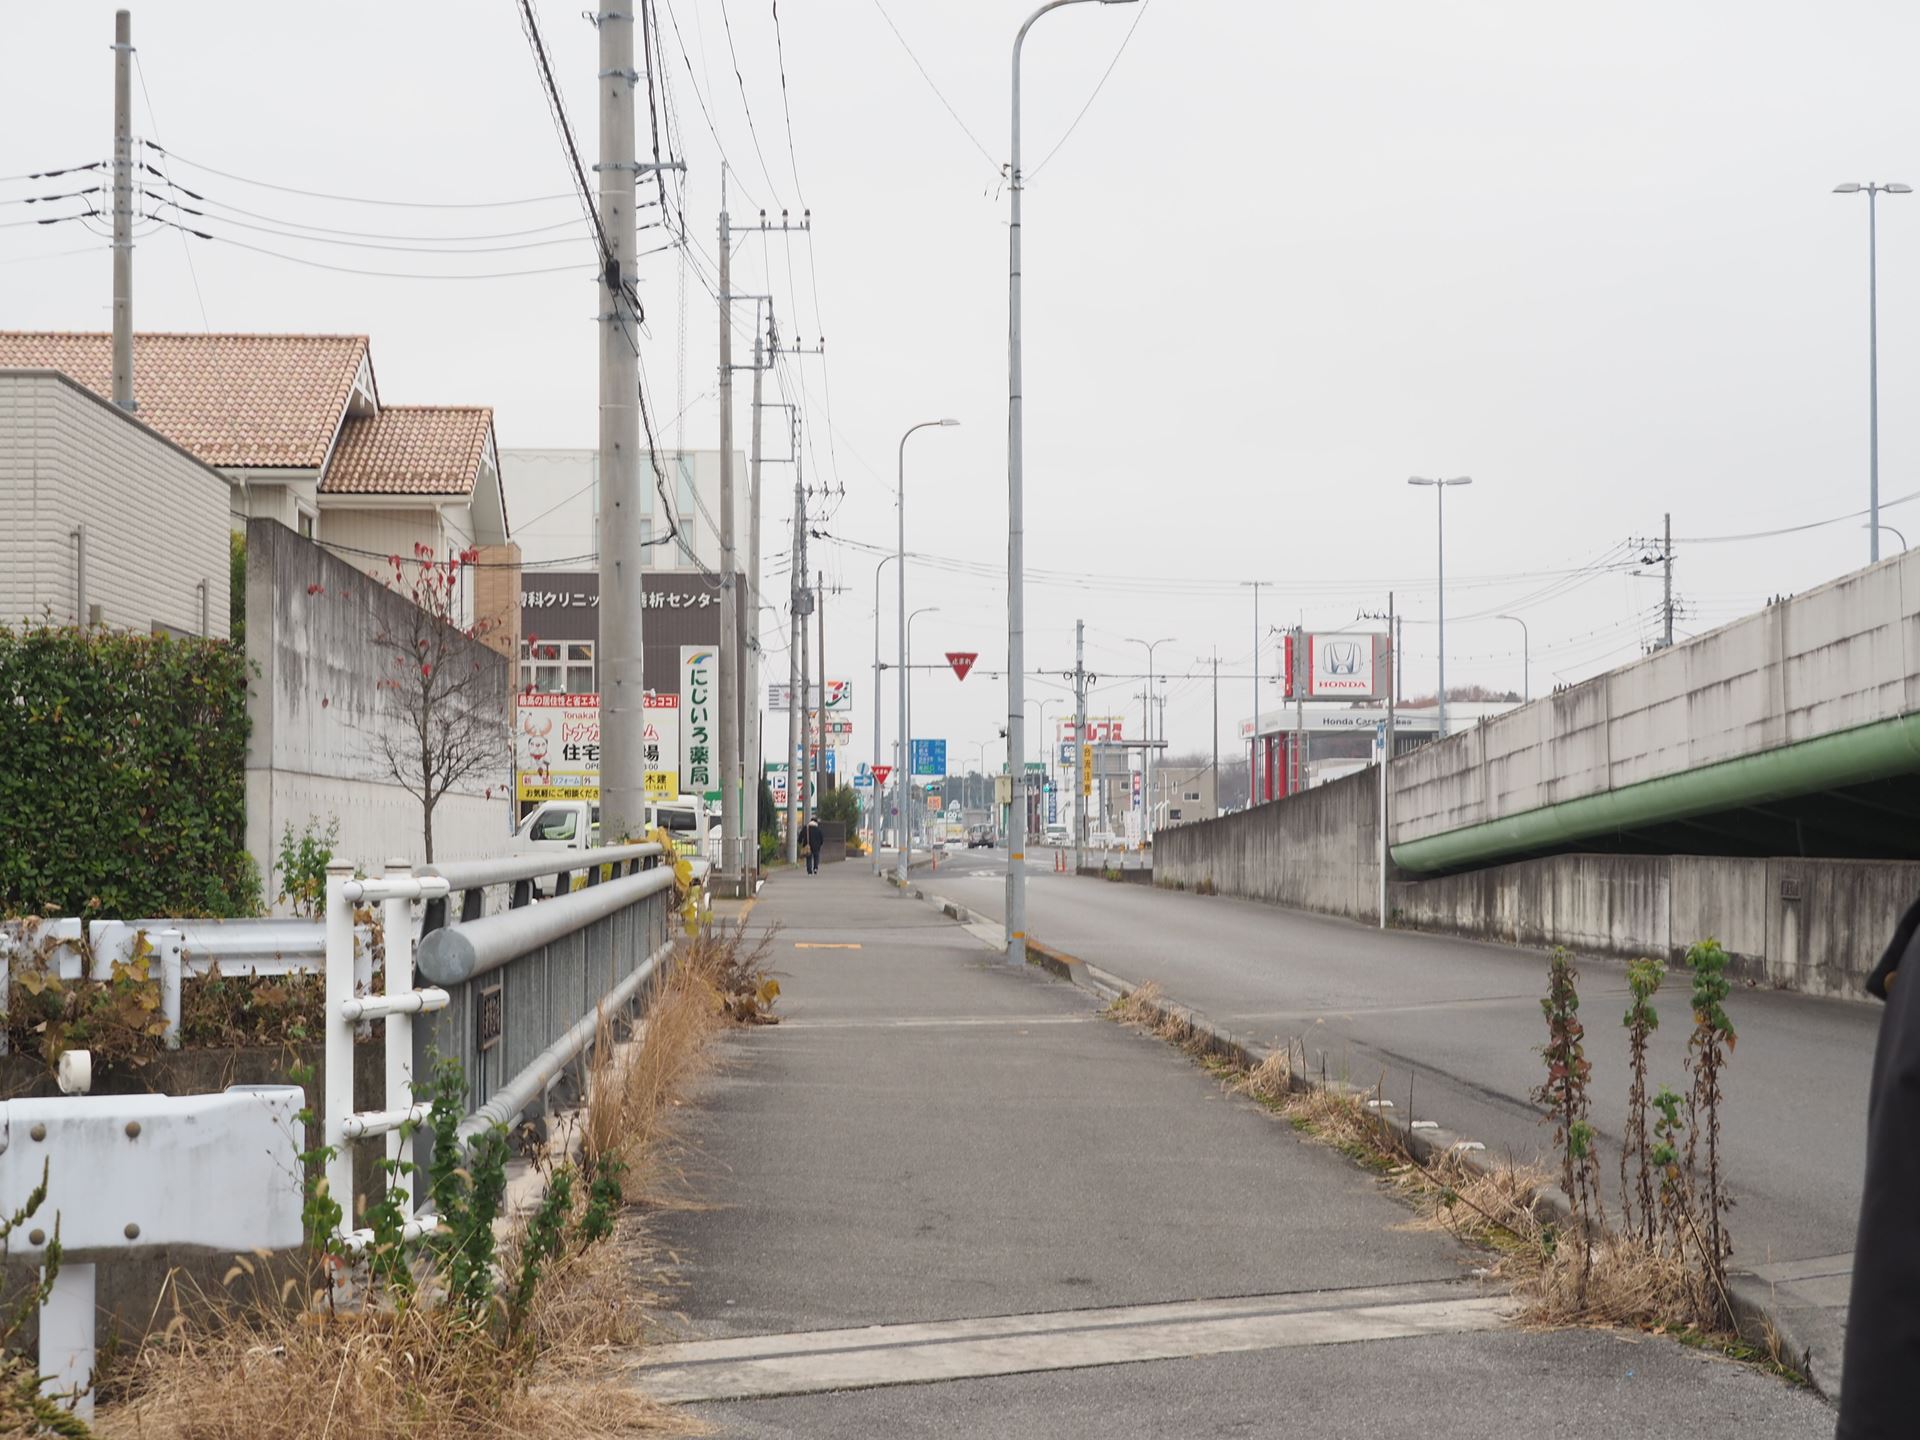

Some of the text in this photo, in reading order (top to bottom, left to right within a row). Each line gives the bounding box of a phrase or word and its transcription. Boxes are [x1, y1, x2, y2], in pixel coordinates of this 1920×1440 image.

[1318, 680, 1367, 689] HONDA
[1322, 717, 1354, 726] Honda
[689, 668, 709, 786] にじいろ薬局
